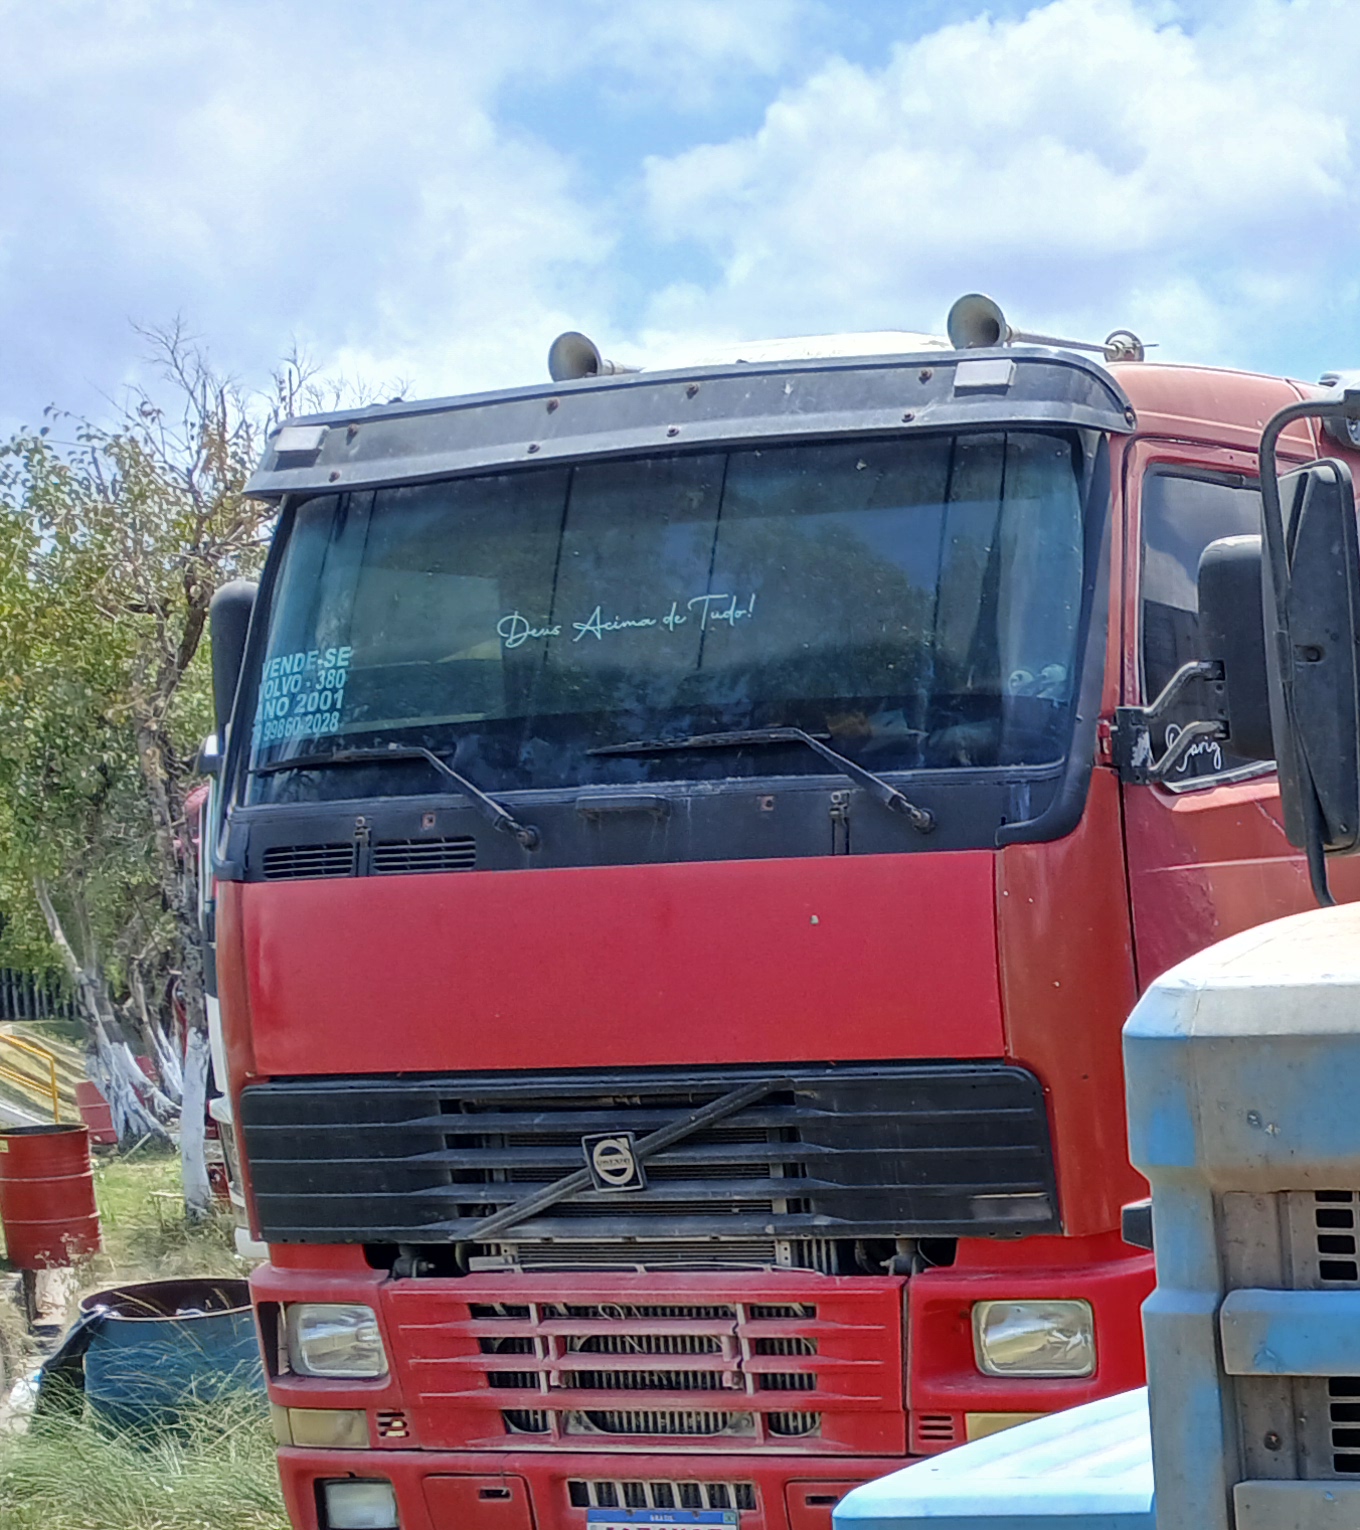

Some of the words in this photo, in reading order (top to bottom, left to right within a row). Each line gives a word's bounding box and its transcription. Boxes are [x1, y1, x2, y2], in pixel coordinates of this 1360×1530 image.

[497, 610, 562, 648] Deus
[572, 605, 656, 643] Acima
[662, 602, 687, 632] de
[687, 593, 756, 632] Tudo!
[263, 646, 352, 678] VENDE-SE
[315, 668, 347, 690] 380
[294, 689, 344, 714] 2001
